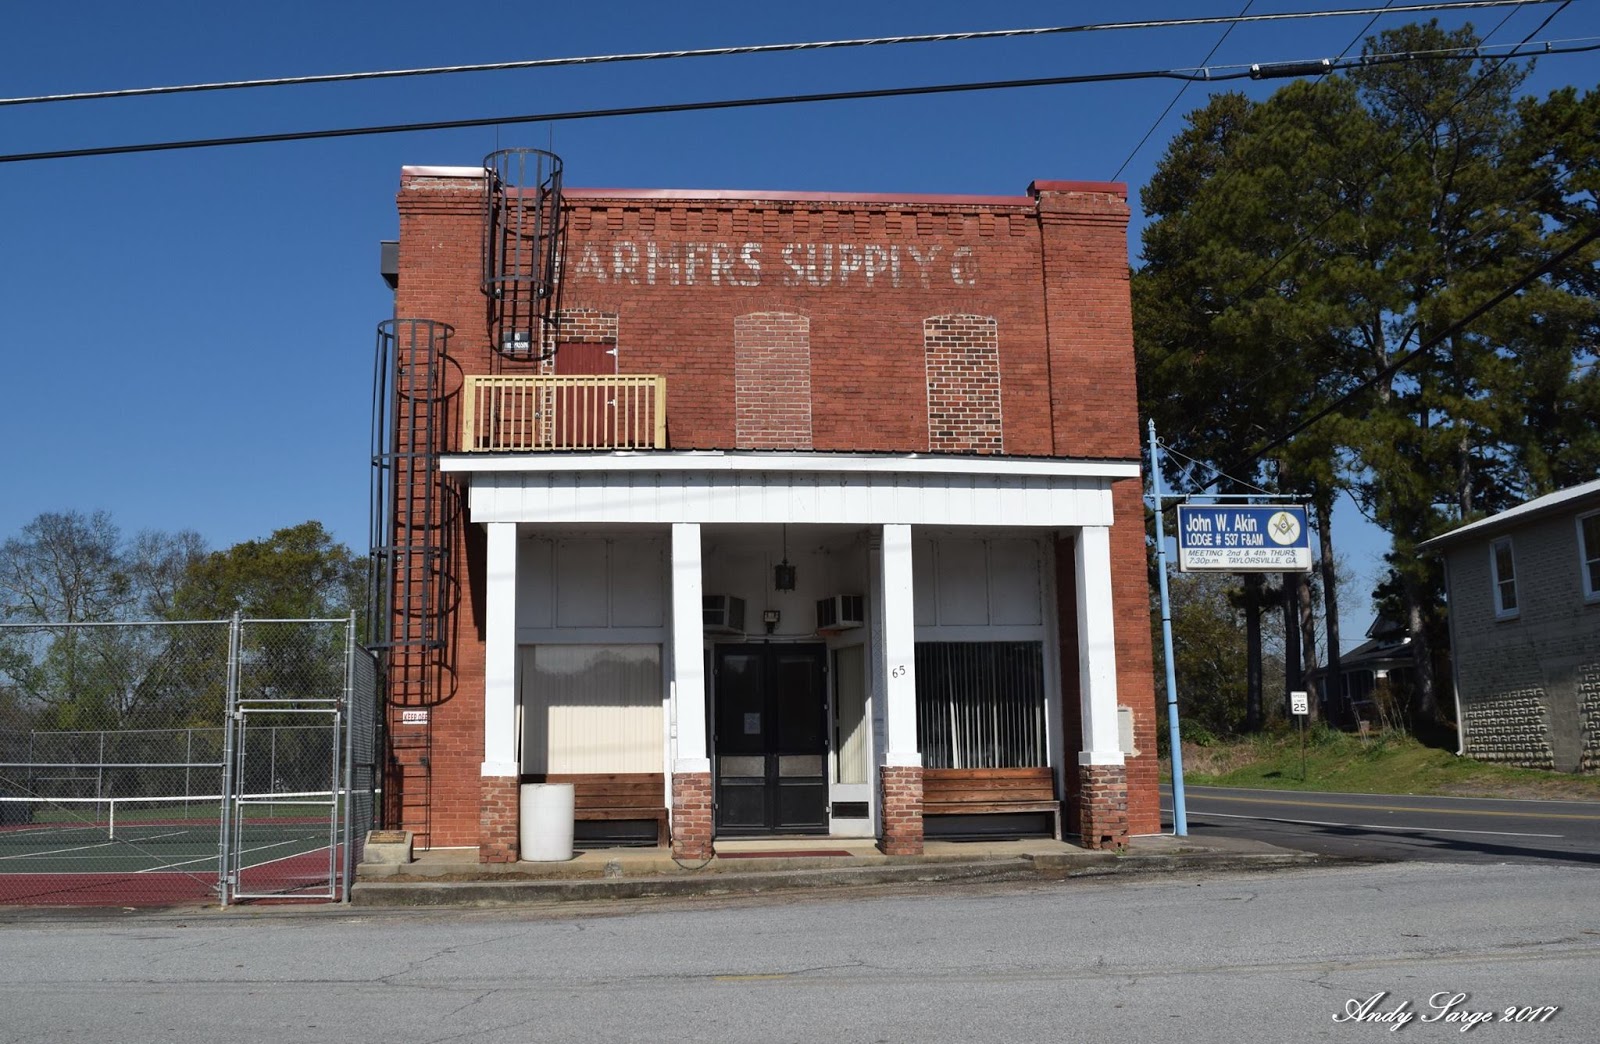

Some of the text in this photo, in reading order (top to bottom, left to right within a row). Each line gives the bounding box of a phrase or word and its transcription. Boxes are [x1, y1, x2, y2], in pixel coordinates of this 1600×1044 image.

[1186, 513, 1257, 532] John W. Akin
[1186, 533, 1264, 546] LODGE # 537 F&AM
[892, 665, 906, 679] 65
[1294, 703, 1306, 712] 25
[404, 713, 417, 721] KEEP
